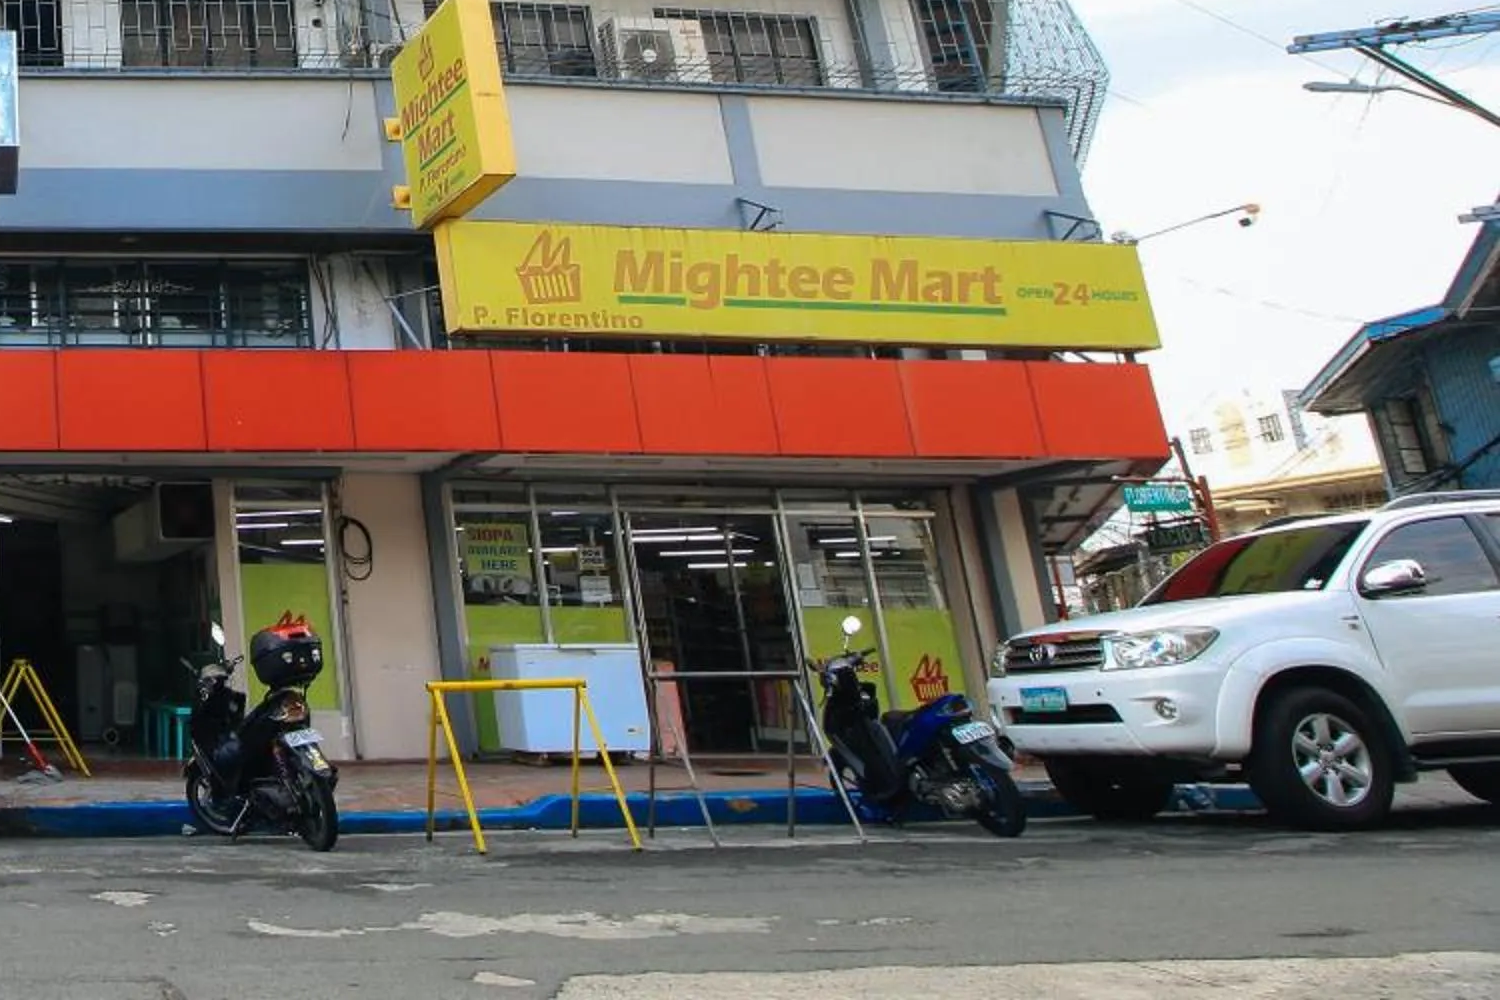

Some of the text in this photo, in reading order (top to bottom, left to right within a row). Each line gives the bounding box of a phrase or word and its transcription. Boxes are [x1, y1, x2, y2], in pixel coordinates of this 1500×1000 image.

[402, 57, 463, 130] Mightee
[416, 111, 455, 162] Mart
[613, 248, 1139, 310] Mightee Mart OPEN 24 HOURS
[474, 306, 644, 330] P. Florentino
